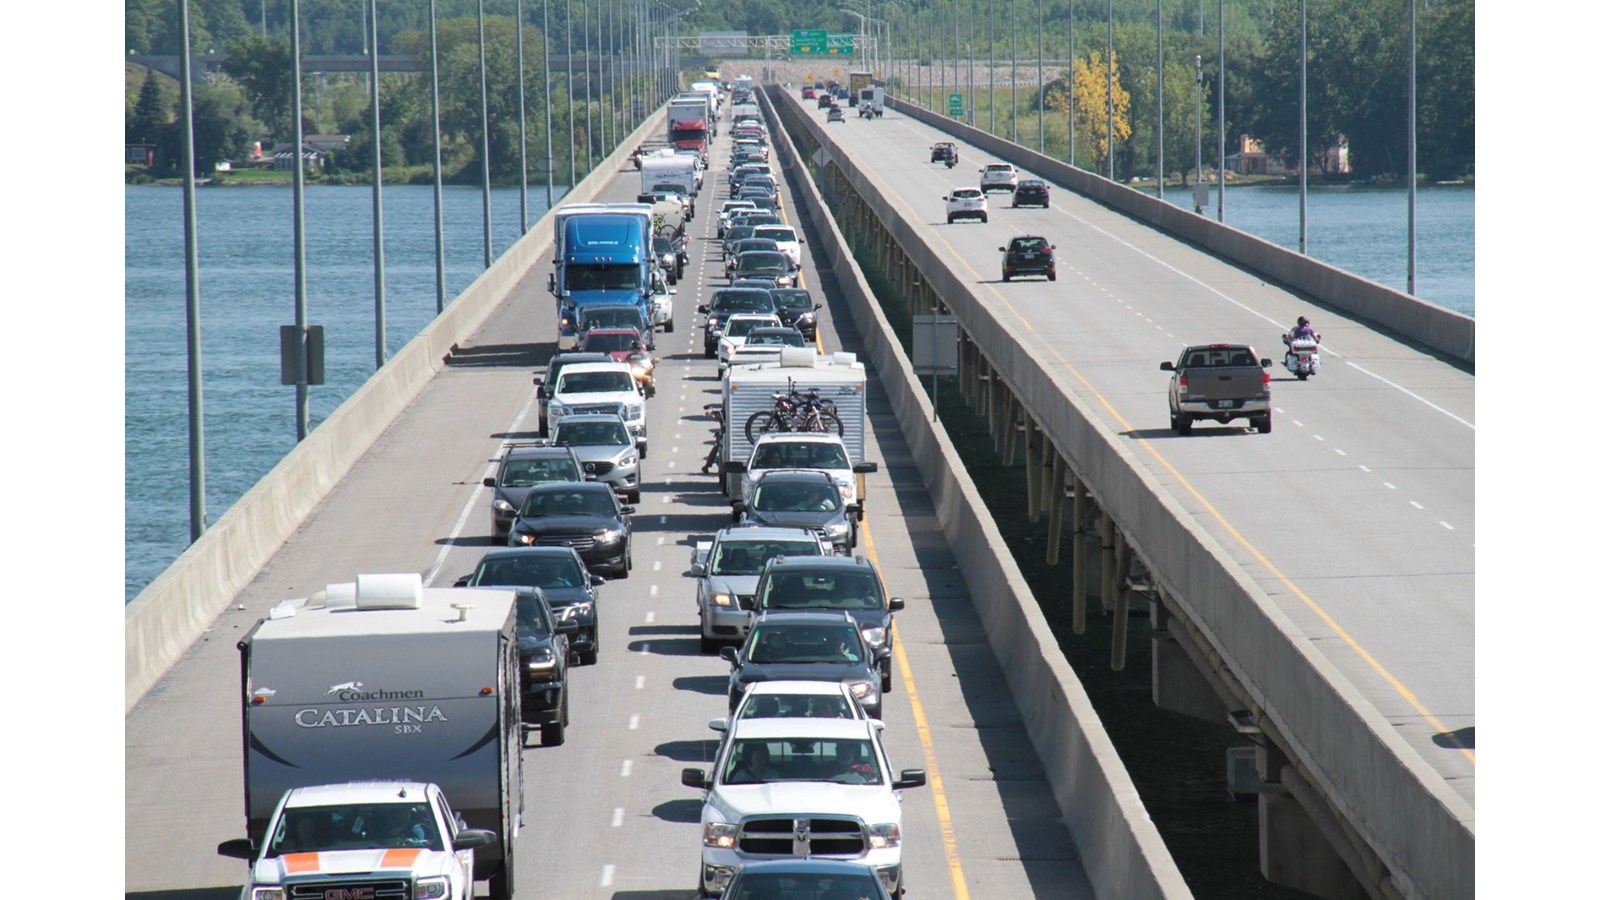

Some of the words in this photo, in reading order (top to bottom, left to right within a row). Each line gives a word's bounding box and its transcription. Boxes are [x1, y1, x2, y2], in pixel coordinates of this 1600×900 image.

[339, 689, 424, 701] Coachmen
[295, 705, 448, 728] CATALINA
[395, 724, 422, 734] SBX
[325, 887, 374, 900] GMC
